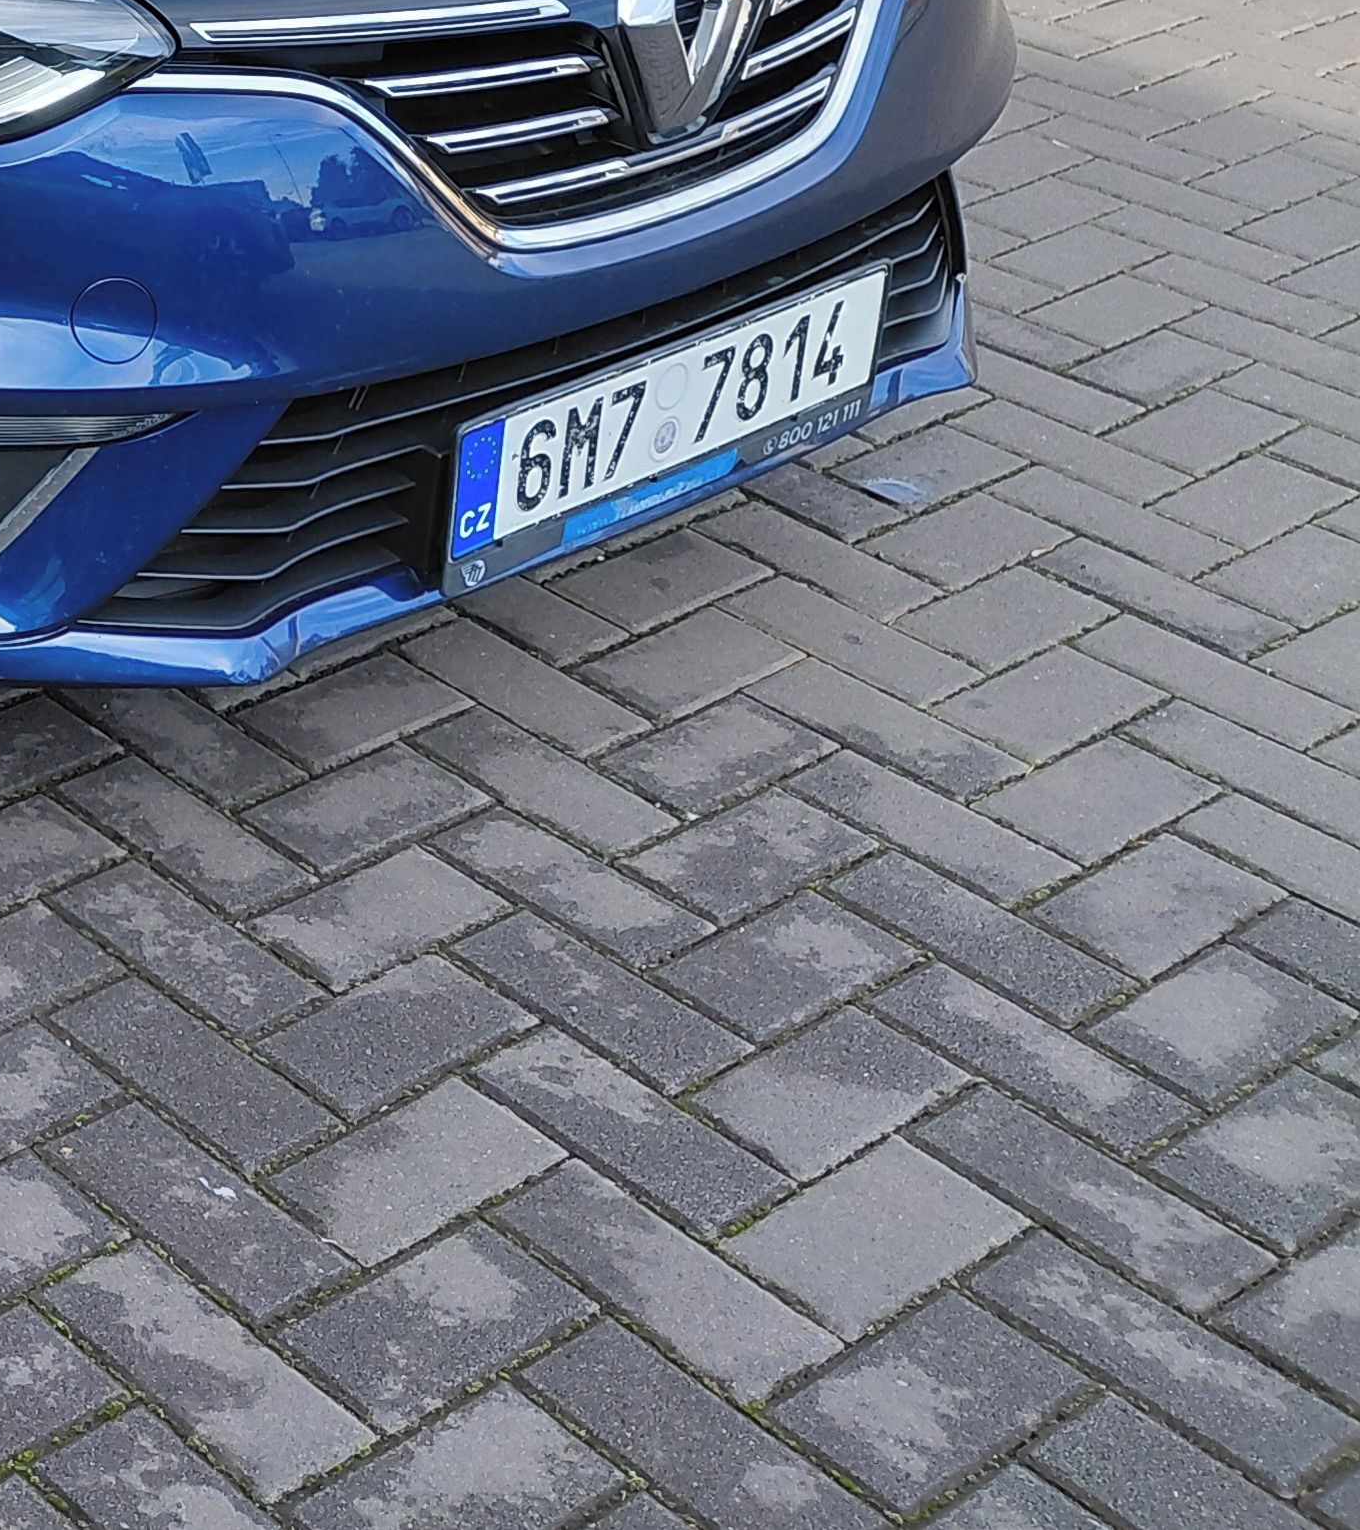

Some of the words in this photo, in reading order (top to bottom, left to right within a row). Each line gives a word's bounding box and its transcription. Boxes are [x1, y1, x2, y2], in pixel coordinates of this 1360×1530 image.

[514, 379, 648, 512] 6M7
[692, 300, 846, 445] 7814
[778, 420, 813, 450] 800
[459, 502, 491, 540] CZ
